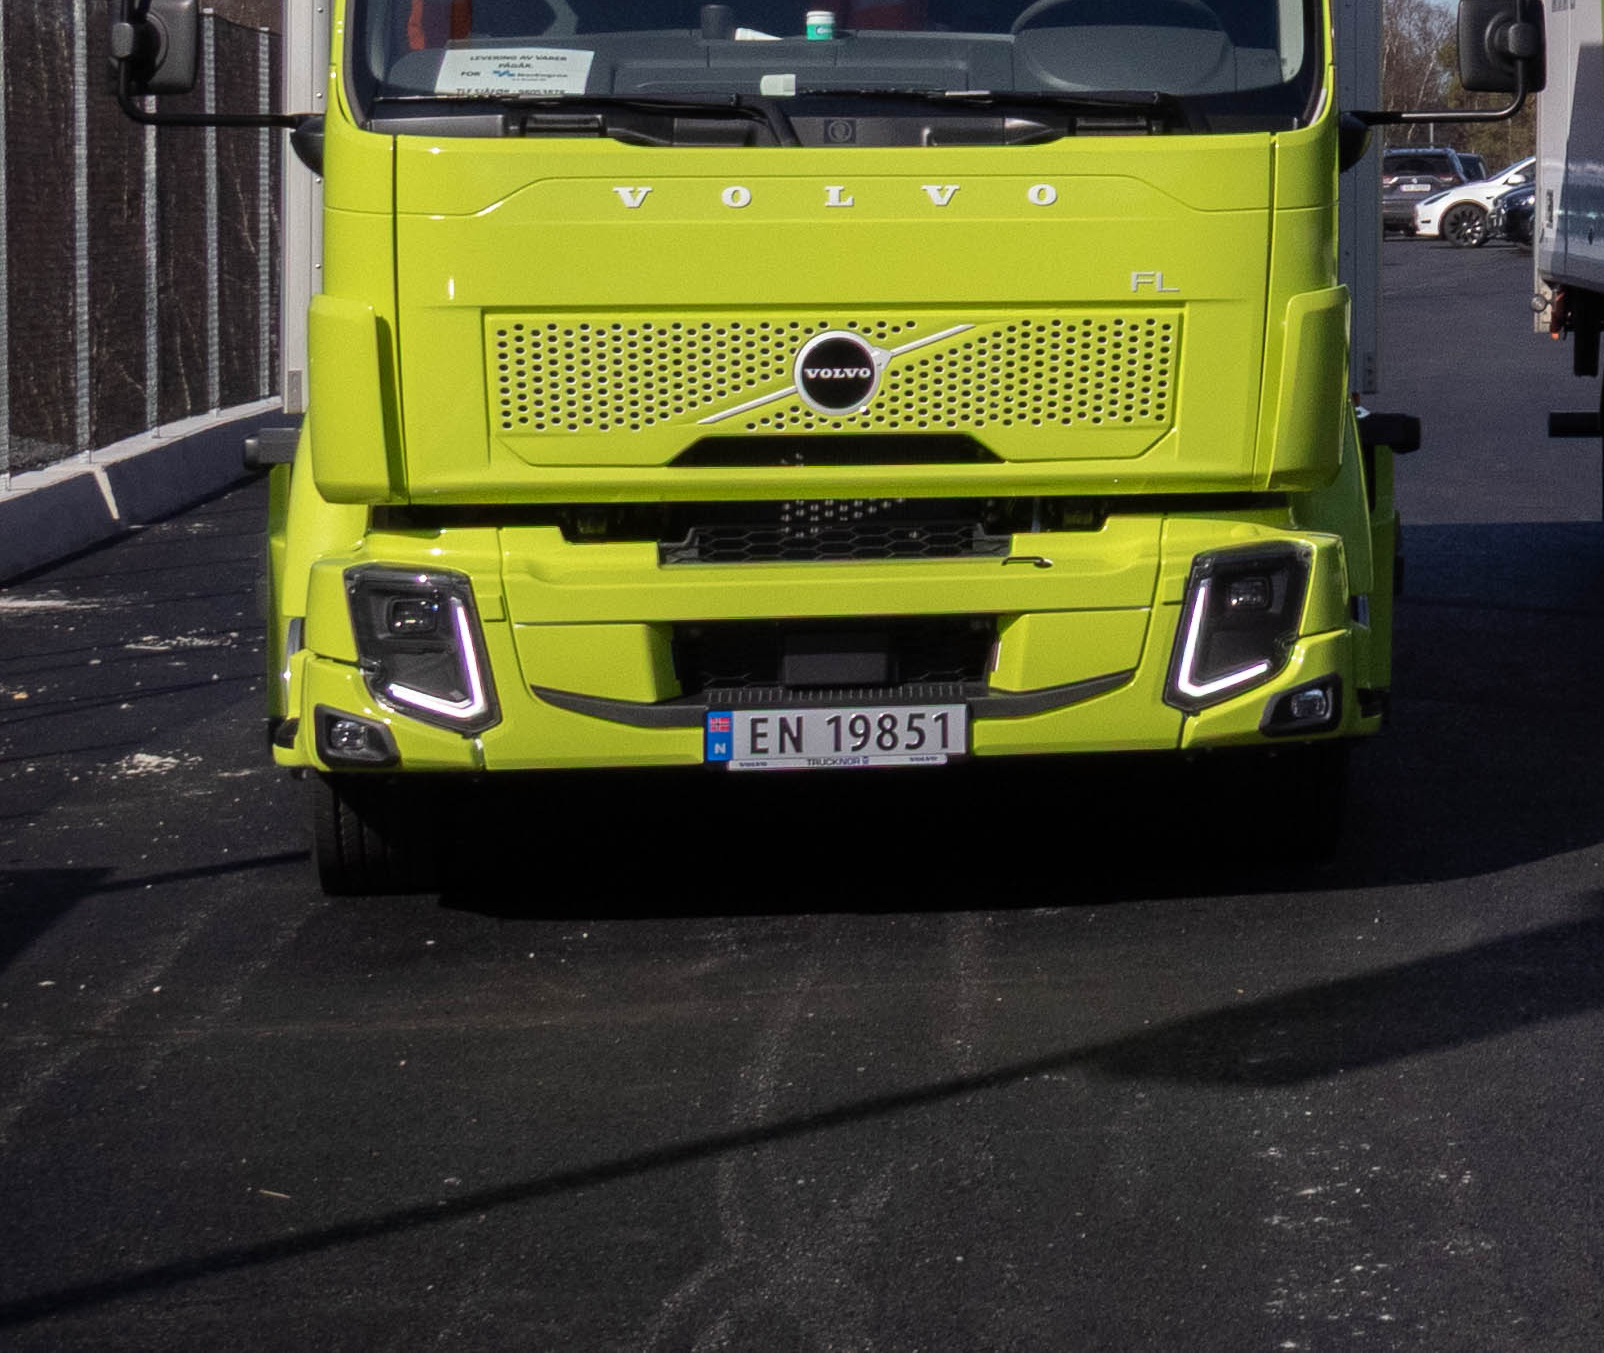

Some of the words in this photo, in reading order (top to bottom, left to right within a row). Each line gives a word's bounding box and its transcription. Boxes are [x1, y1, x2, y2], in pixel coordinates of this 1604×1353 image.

[613, 184, 1058, 208] VOLVO
[1131, 271, 1181, 293] FL
[804, 368, 871, 379] VOLVO
[750, 716, 803, 754] EN
[826, 712, 949, 752] 19851
[714, 743, 726, 754] N
[807, 757, 861, 767] TRUCKNOR
